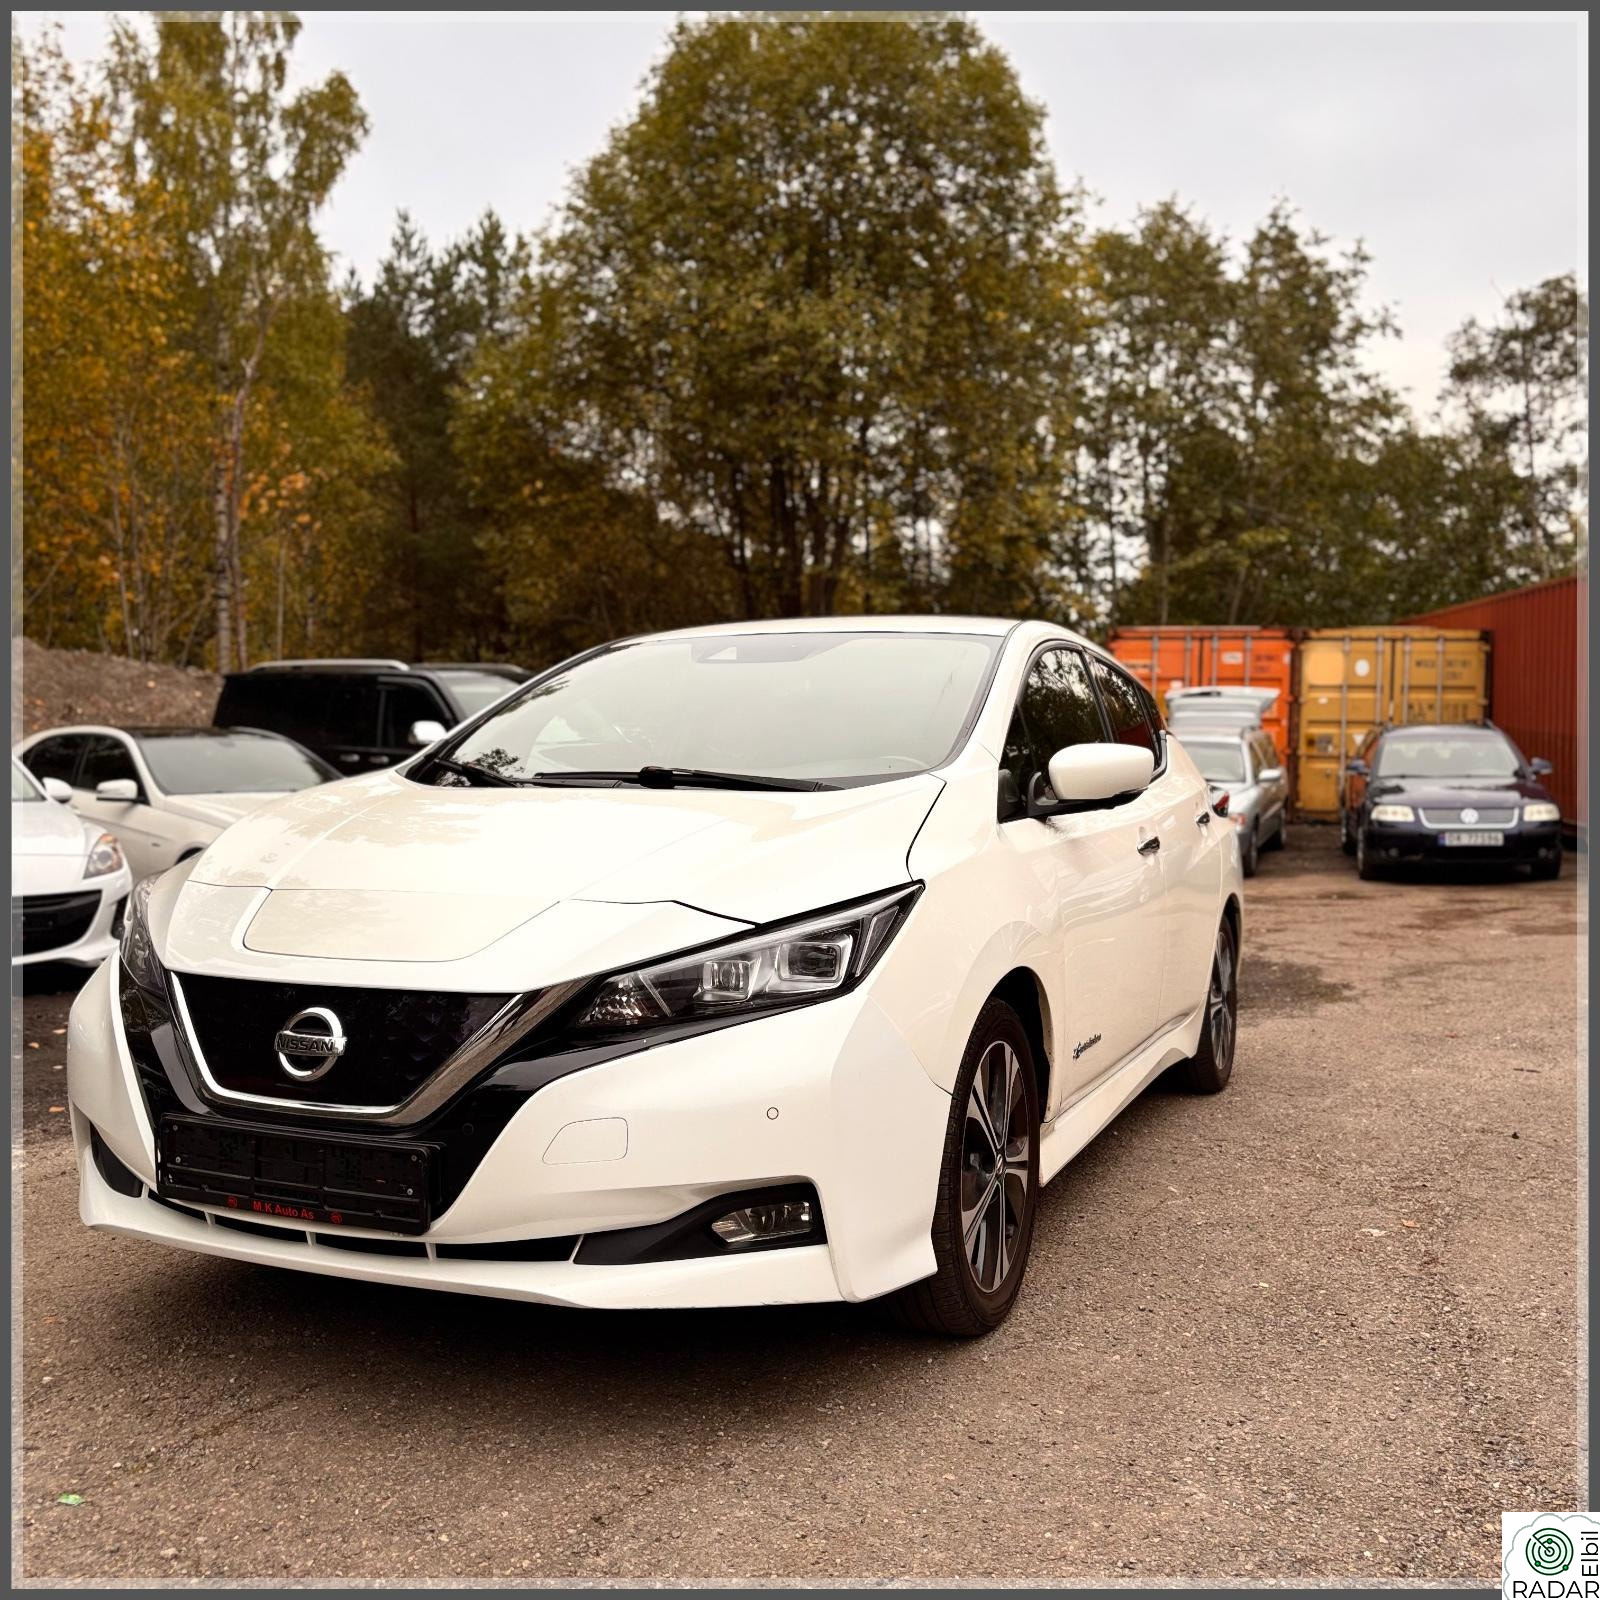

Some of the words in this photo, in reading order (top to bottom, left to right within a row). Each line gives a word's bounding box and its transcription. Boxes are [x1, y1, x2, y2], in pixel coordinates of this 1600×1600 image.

[278, 1033, 334, 1052] NISSAN
[275, 1204, 298, 1217] Auto
[301, 1208, 314, 1220] As
